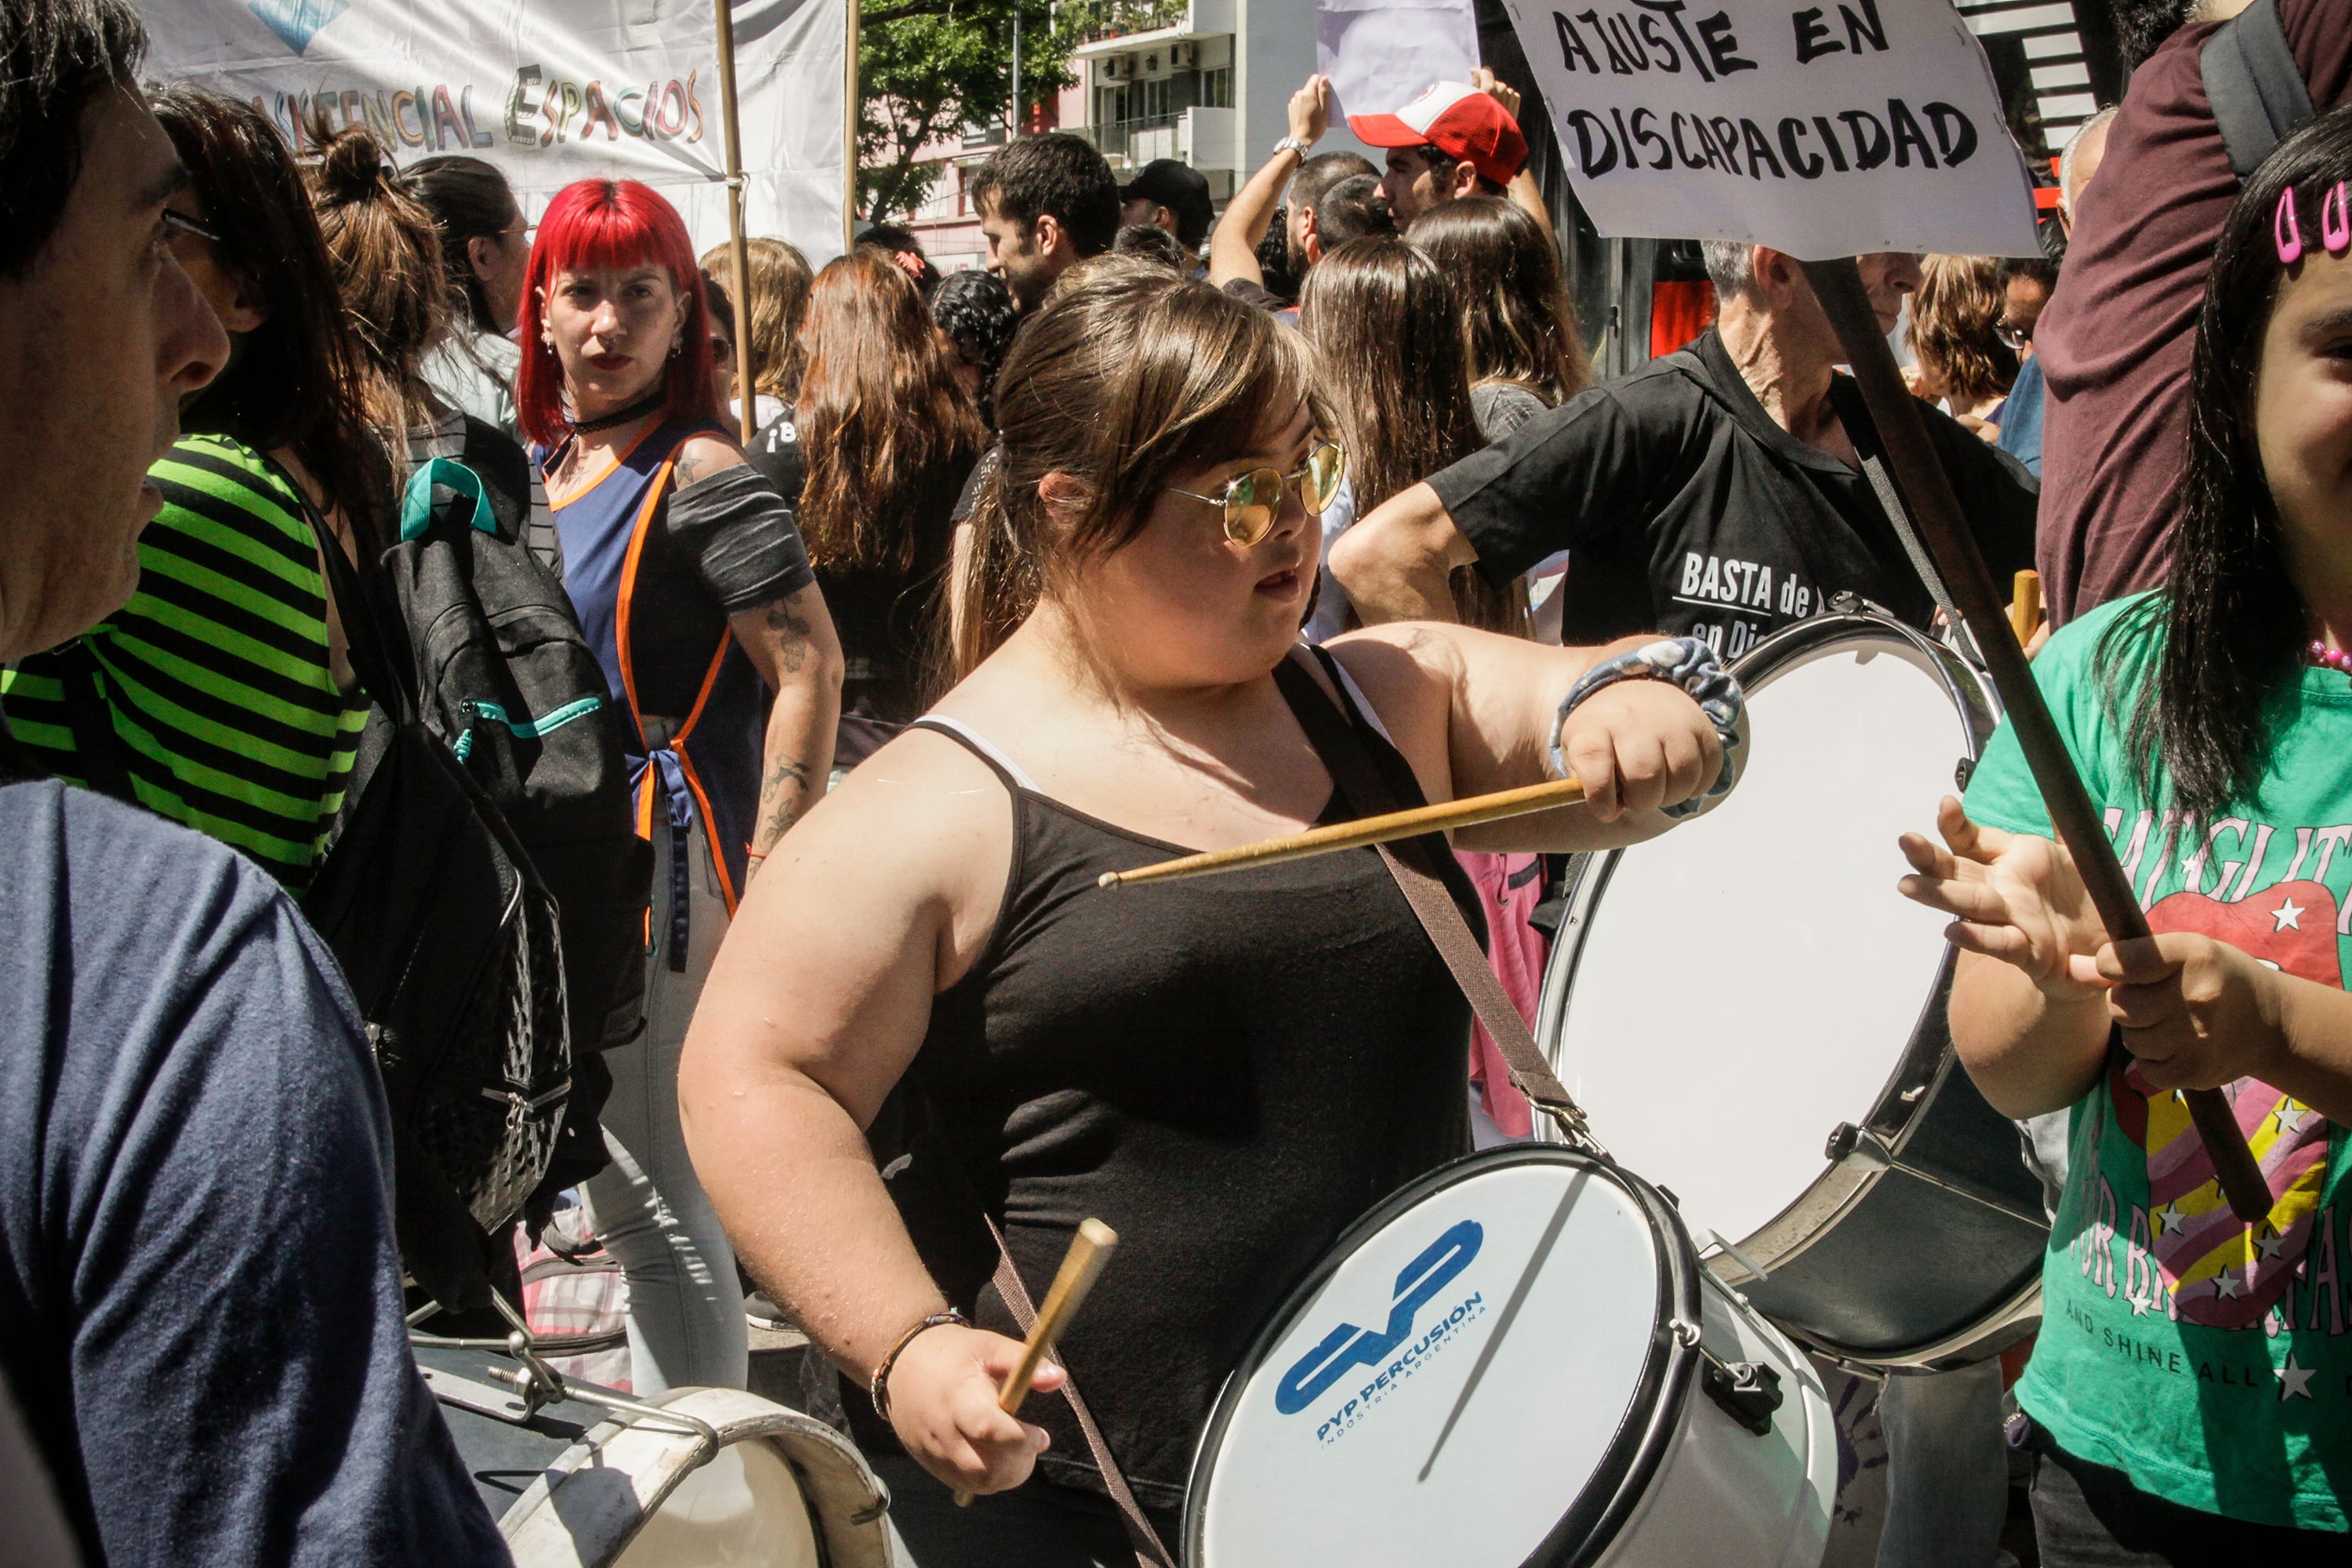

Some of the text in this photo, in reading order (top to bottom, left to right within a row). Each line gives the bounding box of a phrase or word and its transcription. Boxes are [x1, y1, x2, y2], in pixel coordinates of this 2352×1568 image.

[1551, 0, 1889, 82] AJUSTE EN
[504, 64, 704, 147] ESPACIOS
[1567, 98, 1978, 180] DISCAPACIDAD
[1680, 551, 1772, 610] BASTA
[1779, 573, 1809, 618] de
[1316, 1290, 1482, 1441] PYP PERCUSIÓN
[1321, 1306, 1486, 1450] INDUSTRIA ARGENTINA
[2066, 1298, 2259, 1388] AND SHINE ALL
